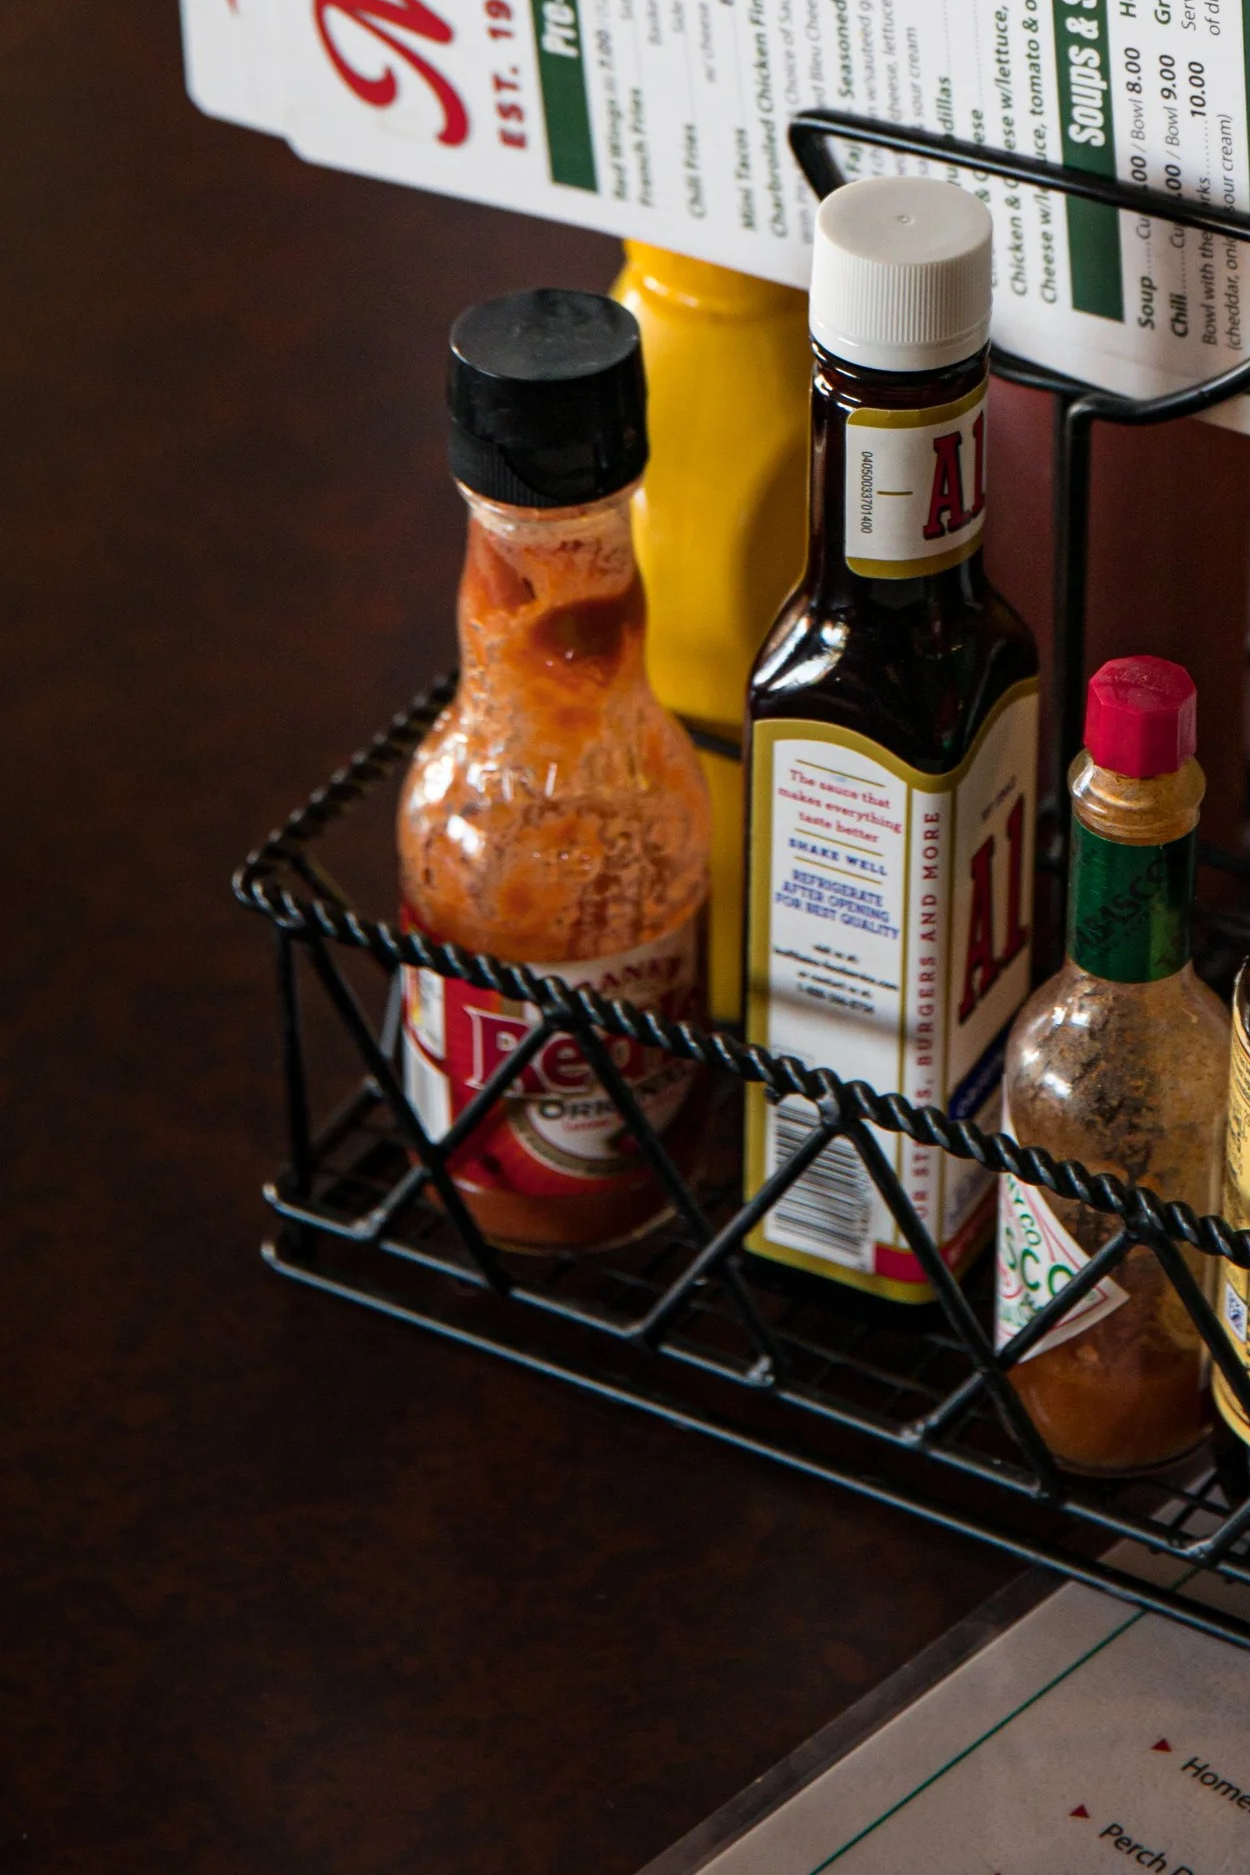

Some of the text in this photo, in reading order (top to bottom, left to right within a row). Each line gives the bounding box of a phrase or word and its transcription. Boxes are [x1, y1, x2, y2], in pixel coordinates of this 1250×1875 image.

[1065, 16, 1099, 40] &
[490, 65, 528, 152] EST.
[1068, 45, 1108, 147] Soups
[777, 786, 903, 834] makes everything
[789, 768, 891, 810] The sauce that
[798, 811, 880, 843] taste better
[788, 837, 888, 876] SHAKE WELL
[916, 811, 941, 1067] BURGERS AND MORE
[1098, 1822, 1168, 1874] Perch
